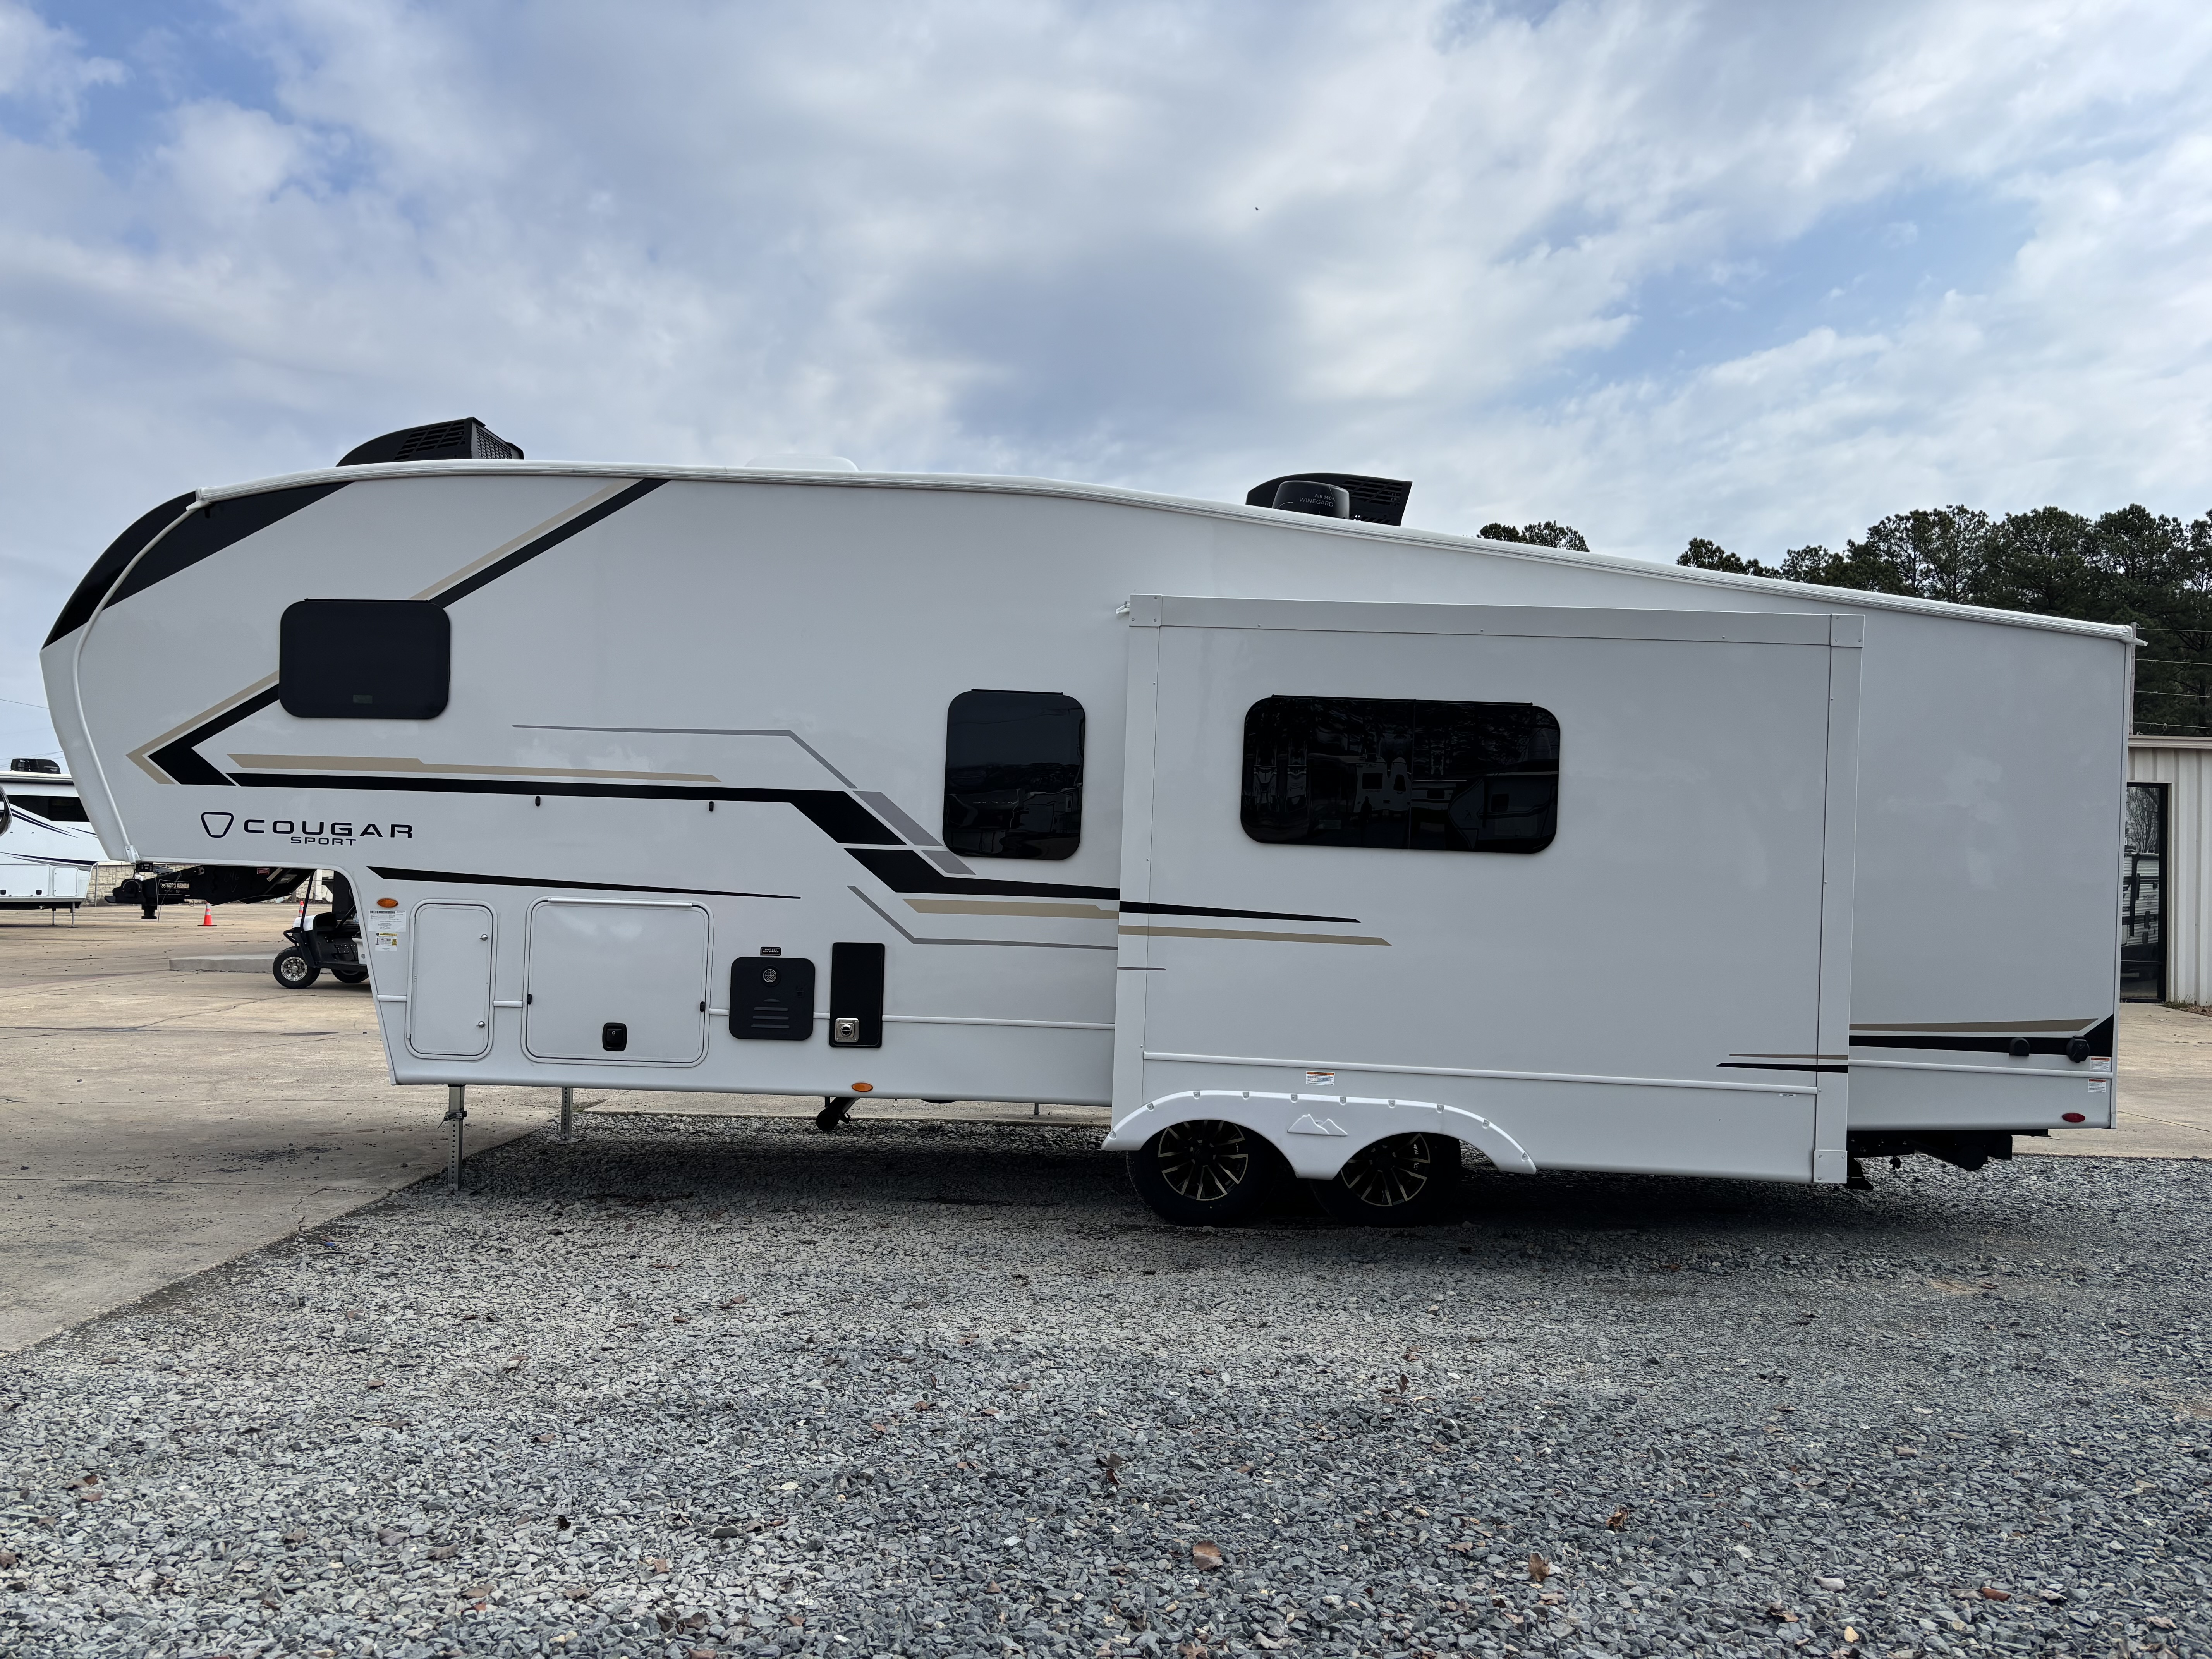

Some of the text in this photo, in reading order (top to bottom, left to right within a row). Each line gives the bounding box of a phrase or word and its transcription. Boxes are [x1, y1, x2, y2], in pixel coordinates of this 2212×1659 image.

[1299, 497, 1333, 507] WINEGARD
[244, 819, 413, 838] COUGAR
[290, 836, 357, 846] SPORT
